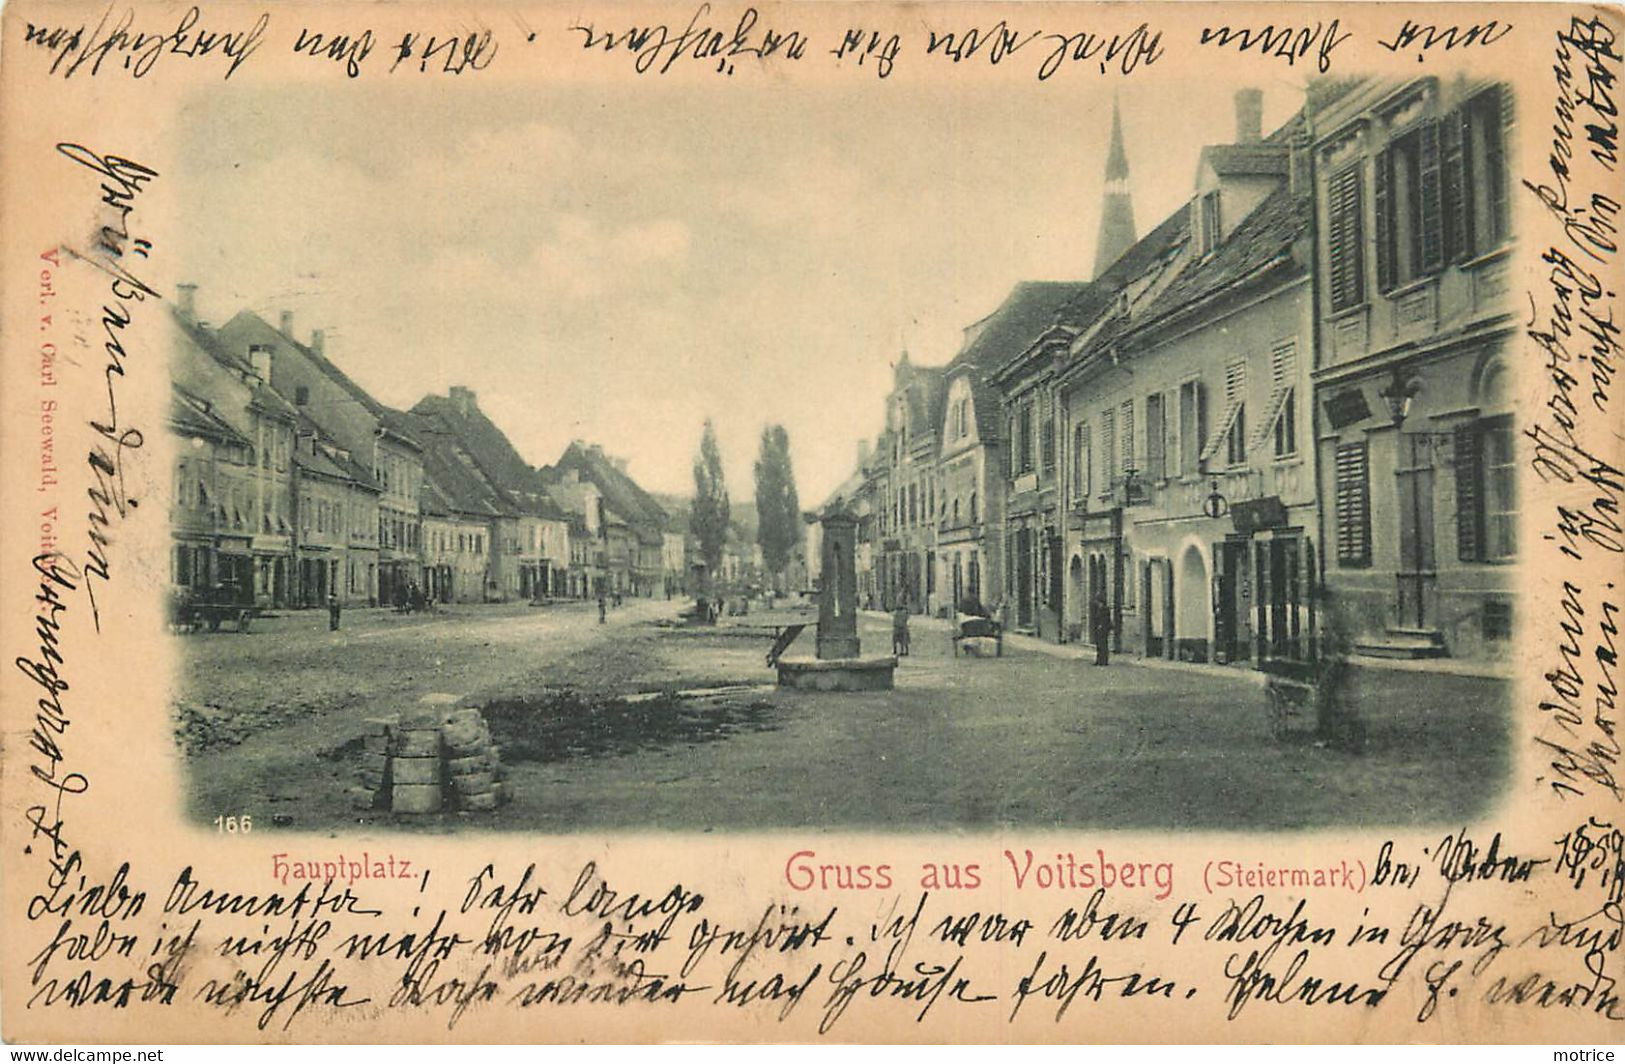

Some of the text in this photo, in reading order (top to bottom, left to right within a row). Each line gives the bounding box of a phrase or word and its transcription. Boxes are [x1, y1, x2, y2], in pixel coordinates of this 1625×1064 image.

[41, 248, 60, 305] Verl.
[41, 314, 53, 331] v.
[40, 343, 58, 387] Carl
[37, 400, 58, 491] Seewald,
[214, 815, 252, 834] 166
[272, 852, 418, 886] Hauptplatz.
[785, 849, 1367, 899] Gruss aus Voitsberg (Steiermark)
[28, 919, 137, 978] habe
[1172, 902, 1200, 945] 4
[1348, 907, 1389, 946] in
